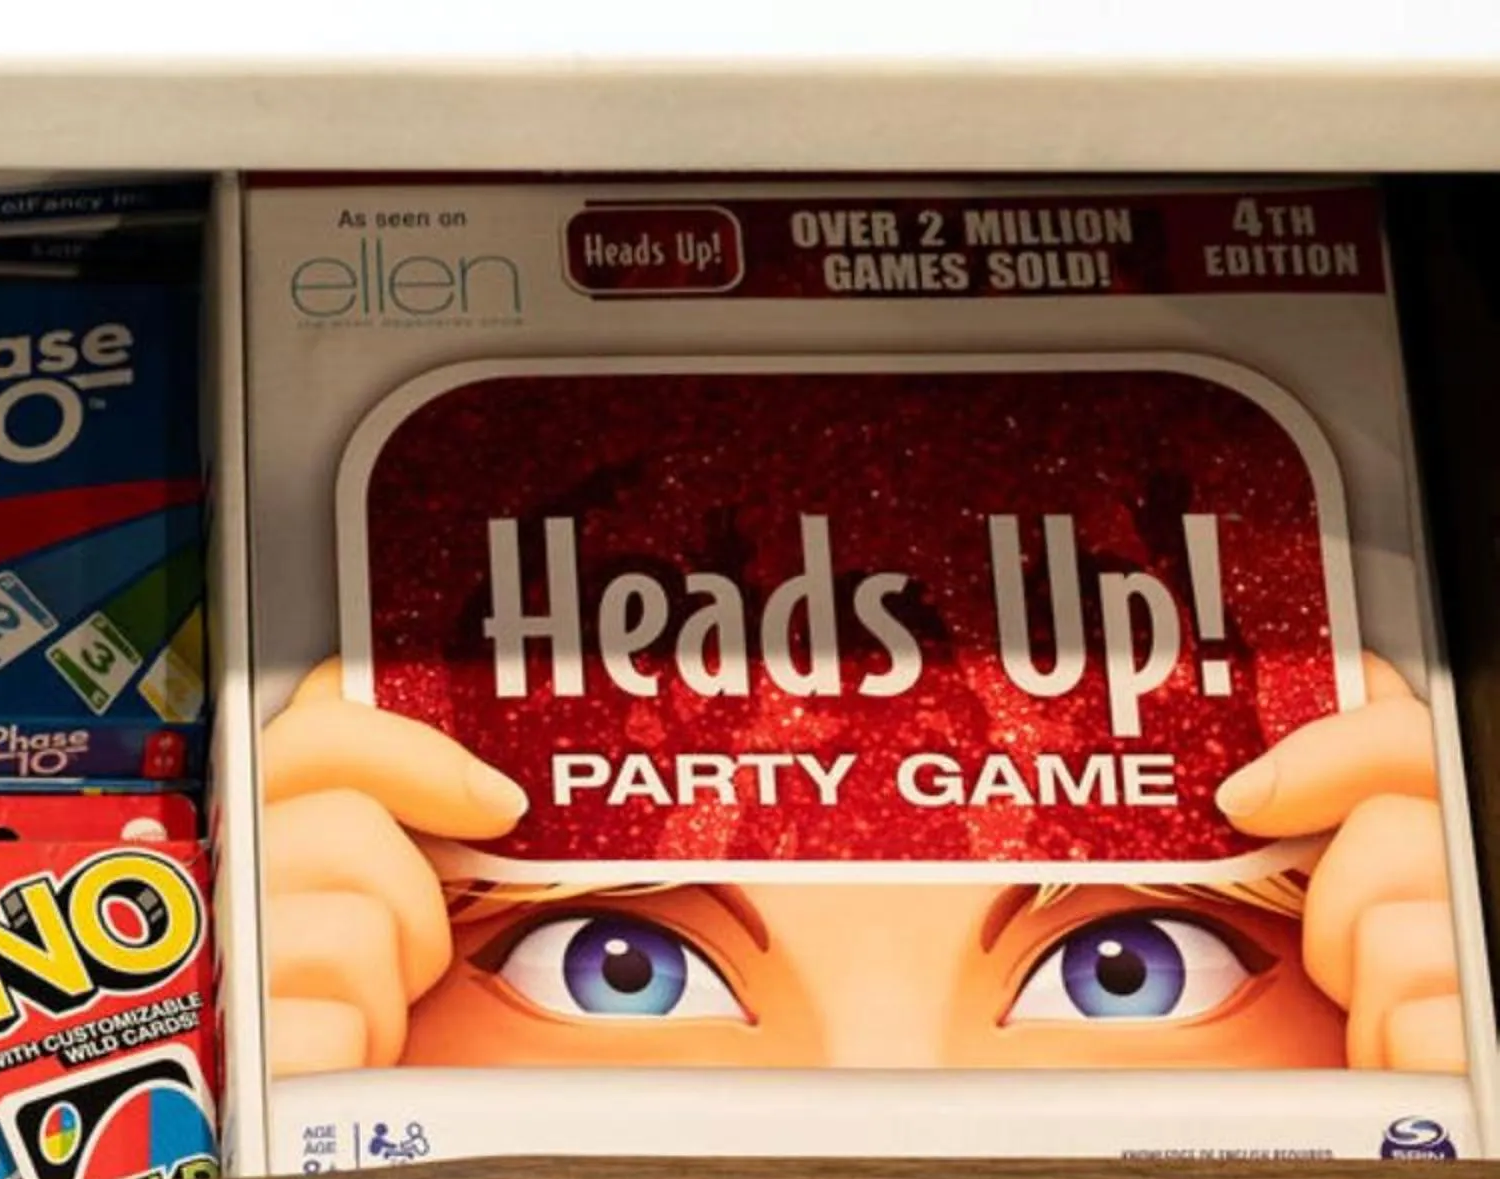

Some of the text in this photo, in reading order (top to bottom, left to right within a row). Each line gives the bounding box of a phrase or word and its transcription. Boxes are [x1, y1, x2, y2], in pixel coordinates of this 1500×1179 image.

[338, 209, 467, 228] As seen on
[791, 208, 1134, 248] OVER 2 MILLION
[1232, 198, 1317, 238] 4TH
[583, 231, 723, 272] Heads Up!
[823, 250, 1111, 292] GAMES SOLD!
[1204, 243, 1360, 278] EDITION
[290, 237, 523, 318] ellen
[484, 512, 1236, 738] Heads Up!
[79, 640, 117, 678] 3
[15, 749, 68, 776] 10
[550, 752, 1179, 807] PARTY GAME
[43, 992, 203, 1052] CUSTOMIZABLE
[63, 1014, 201, 1064] WILD CARDS!
[303, 1125, 337, 1139] AGE
